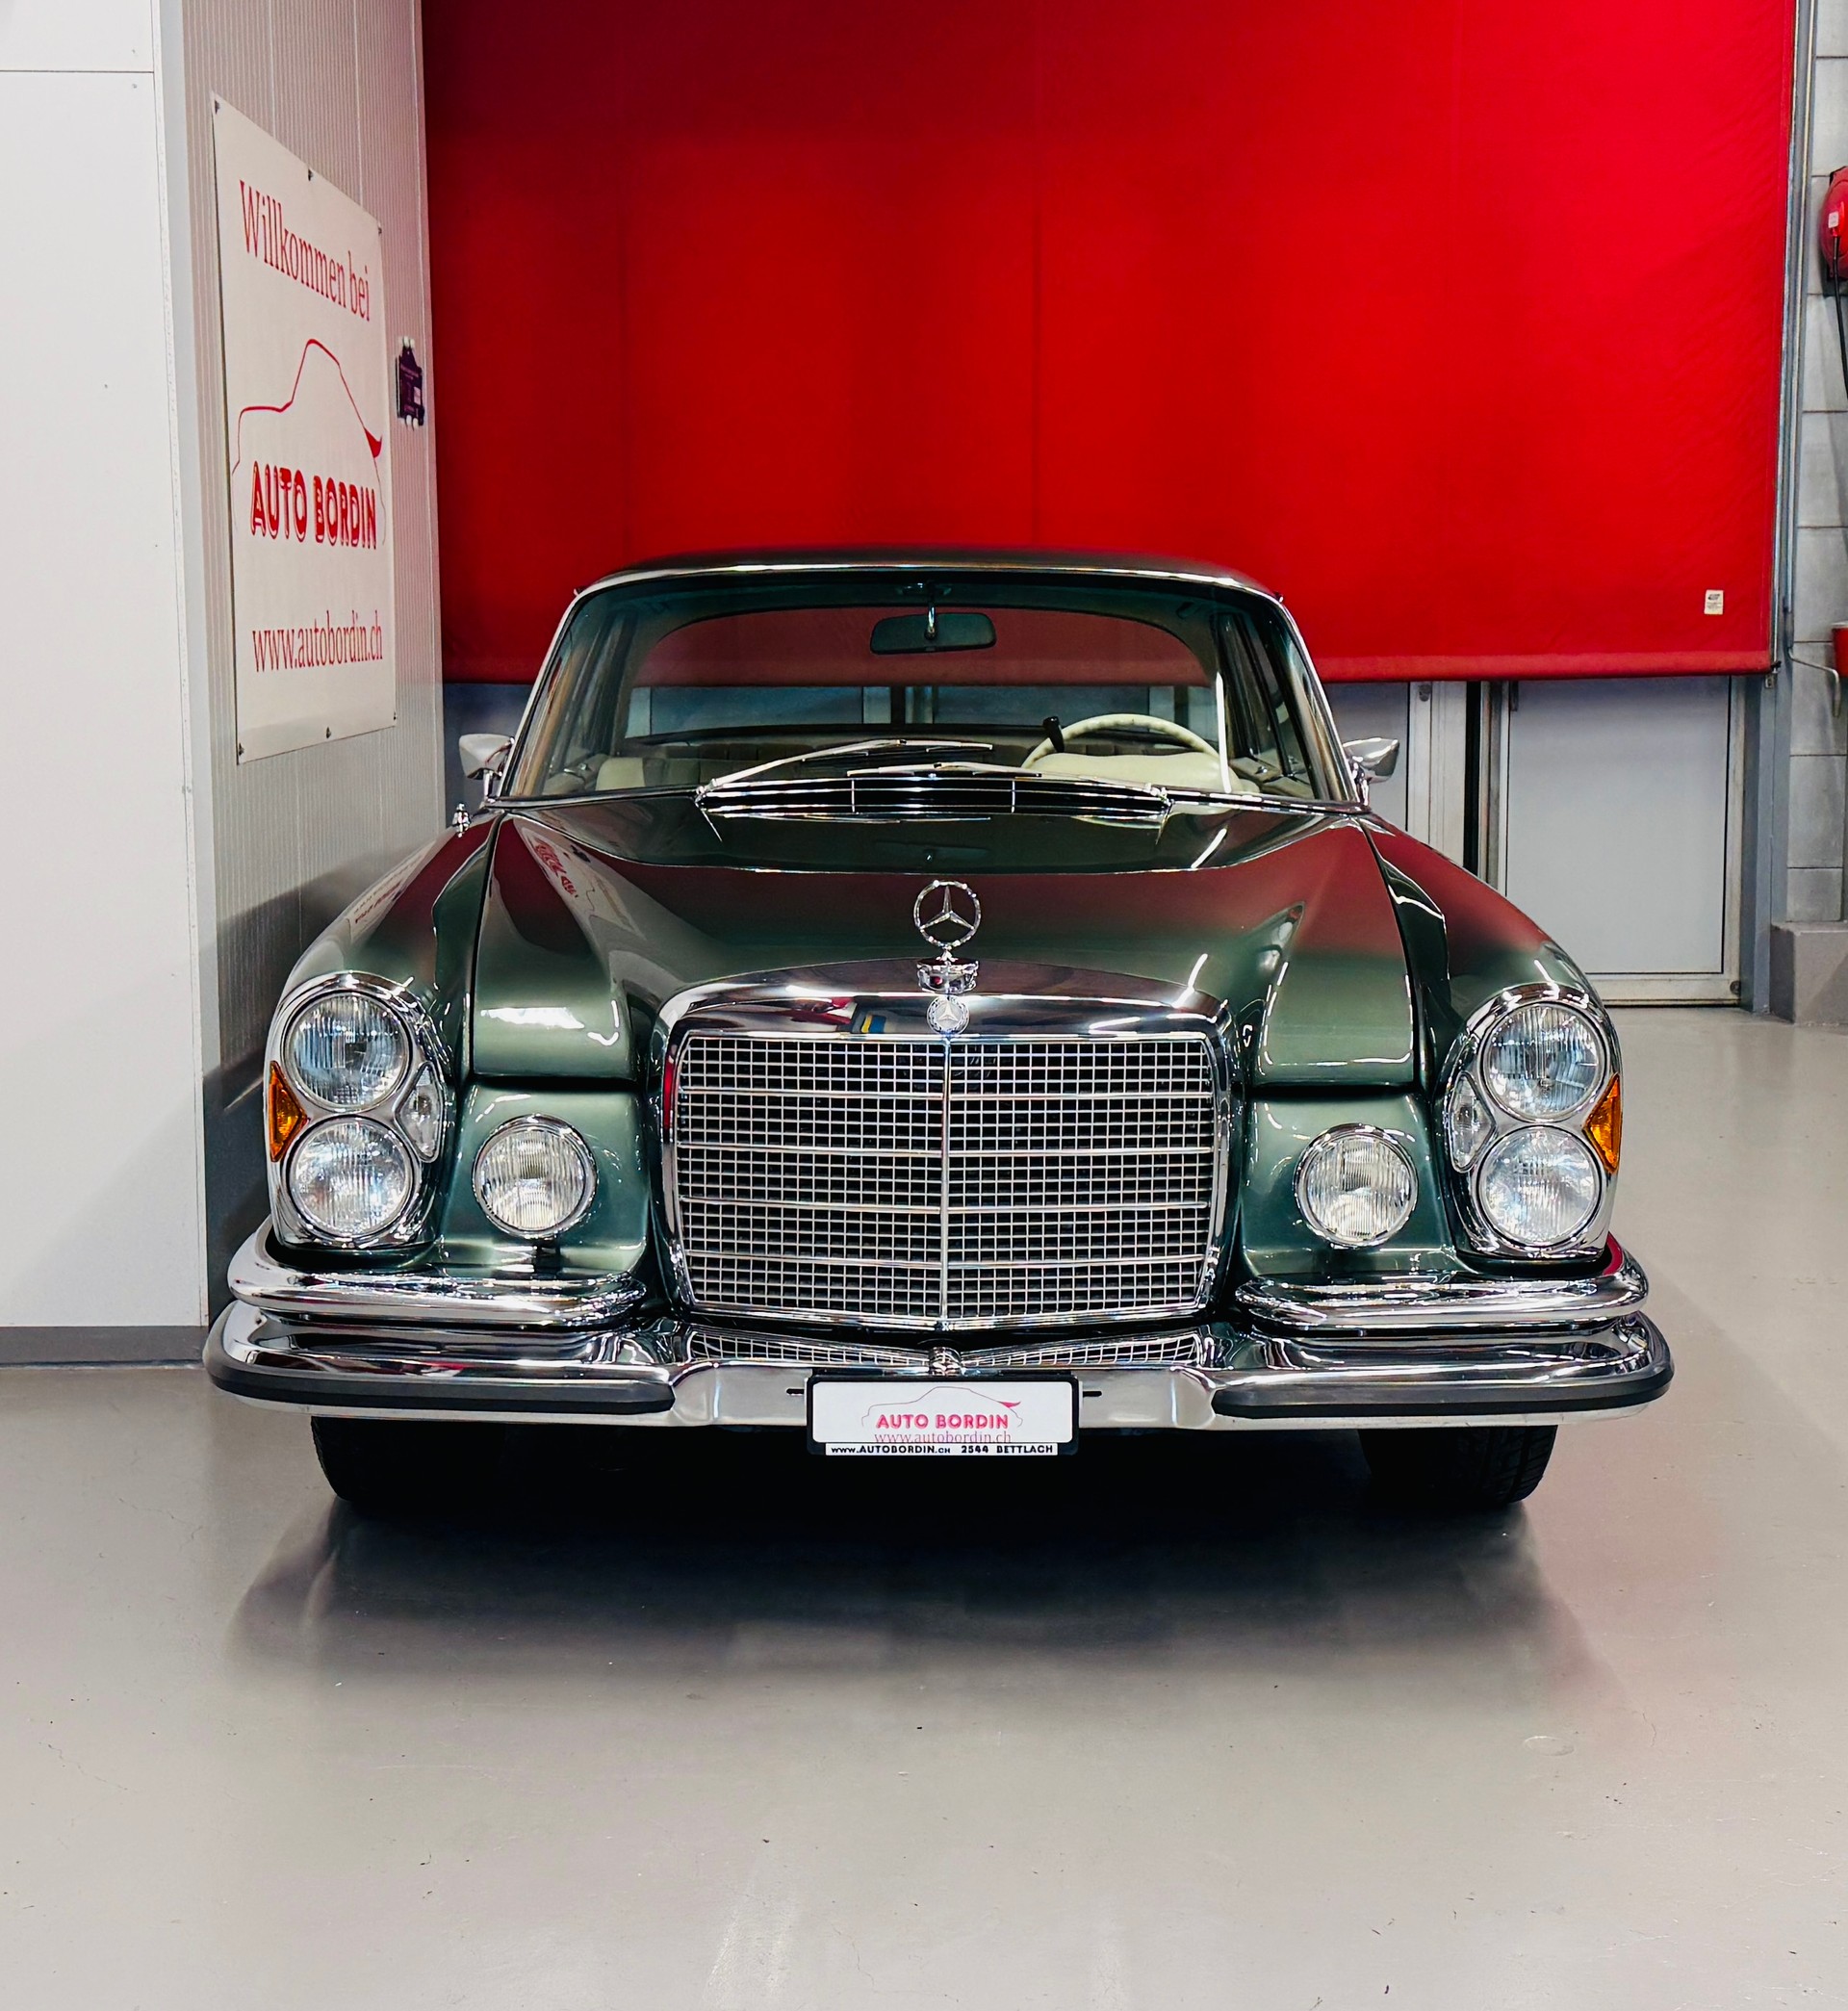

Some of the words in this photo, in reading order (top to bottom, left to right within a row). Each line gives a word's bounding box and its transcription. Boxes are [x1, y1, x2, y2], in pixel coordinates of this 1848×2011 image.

[240, 179, 346, 309] Willkommen
[347, 250, 371, 322] bei
[251, 460, 308, 543] AUTO
[313, 475, 376, 550] BORDIN
[252, 609, 383, 673] www.autobordin.ch
[874, 1431, 1012, 1443] www.autobordin.ch
[876, 1413, 929, 1430] AUTO
[935, 1413, 1009, 1430] BORDIN
[961, 1445, 989, 1454] 2544
[996, 1445, 1053, 1454] BETTLACH
